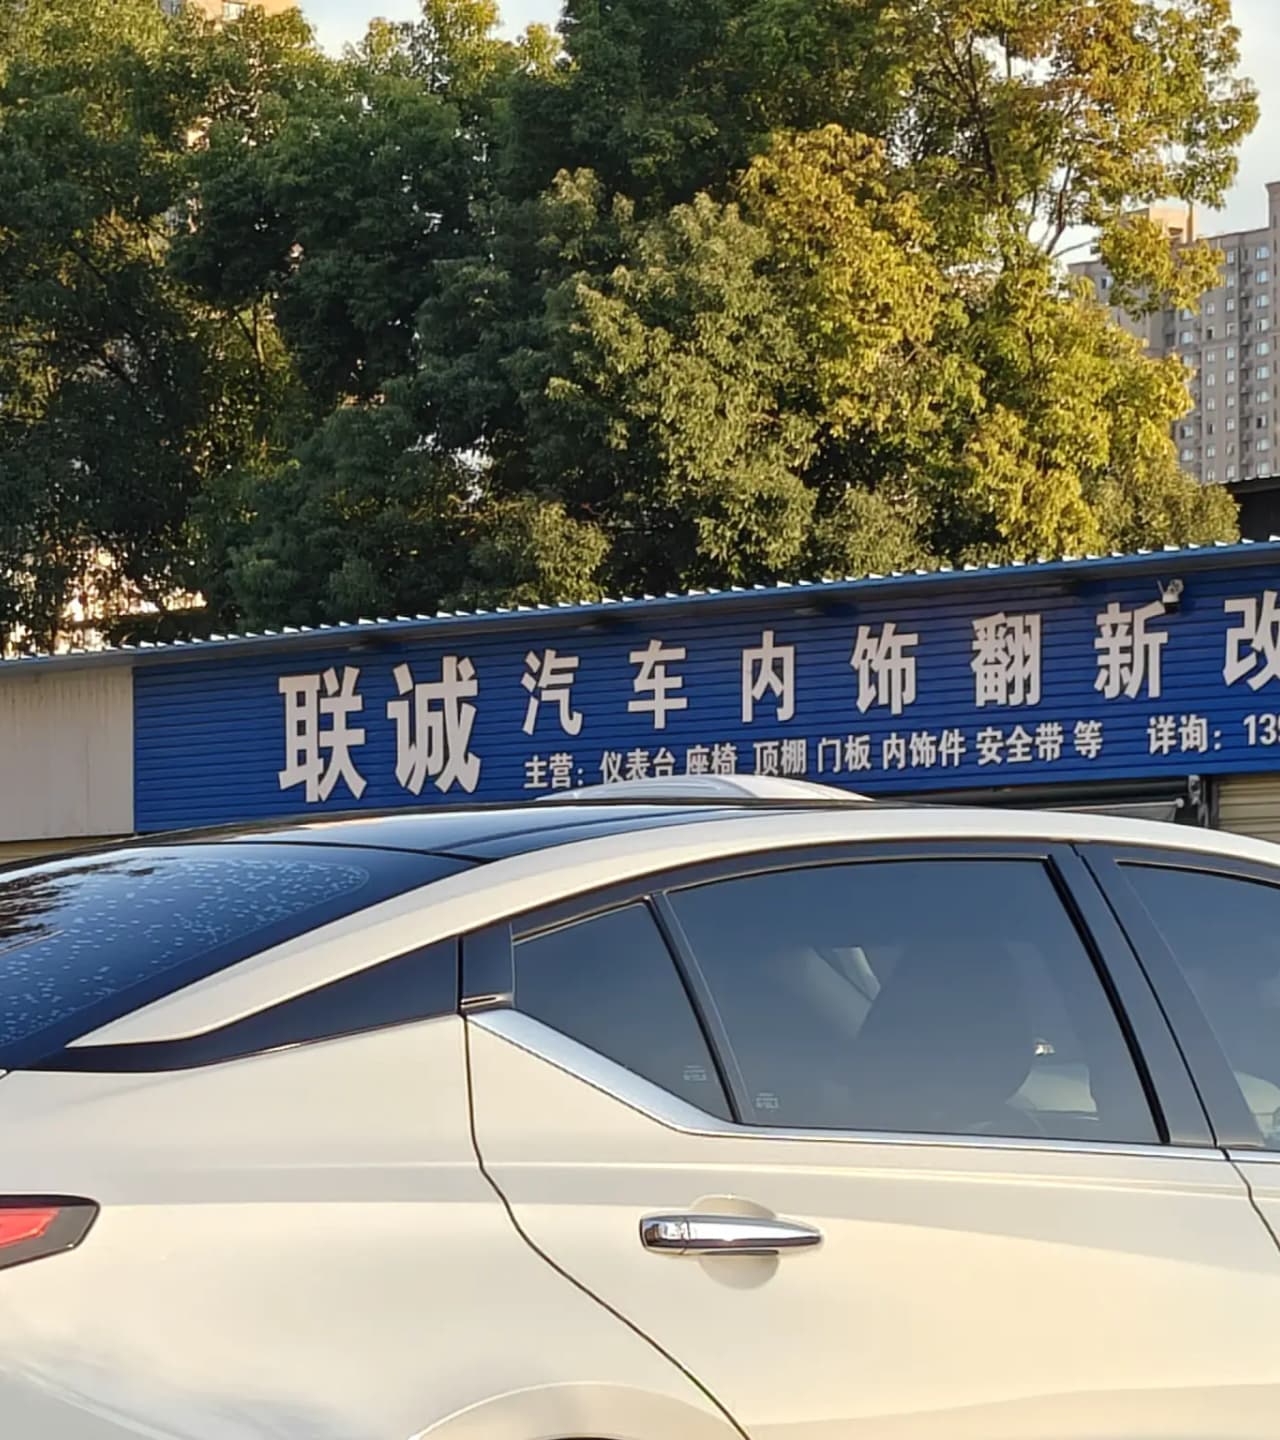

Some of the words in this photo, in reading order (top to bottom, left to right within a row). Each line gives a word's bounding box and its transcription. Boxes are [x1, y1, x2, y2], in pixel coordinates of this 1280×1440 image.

[277, 655, 481, 803] 联诚
[686, 742, 738, 776] 座椅
[752, 738, 807, 776] 顶棚
[817, 734, 872, 774] 门板
[882, 728, 967, 771] 内饰件
[976, 721, 1064, 766] 安全带
[1073, 719, 1104, 760] 等
